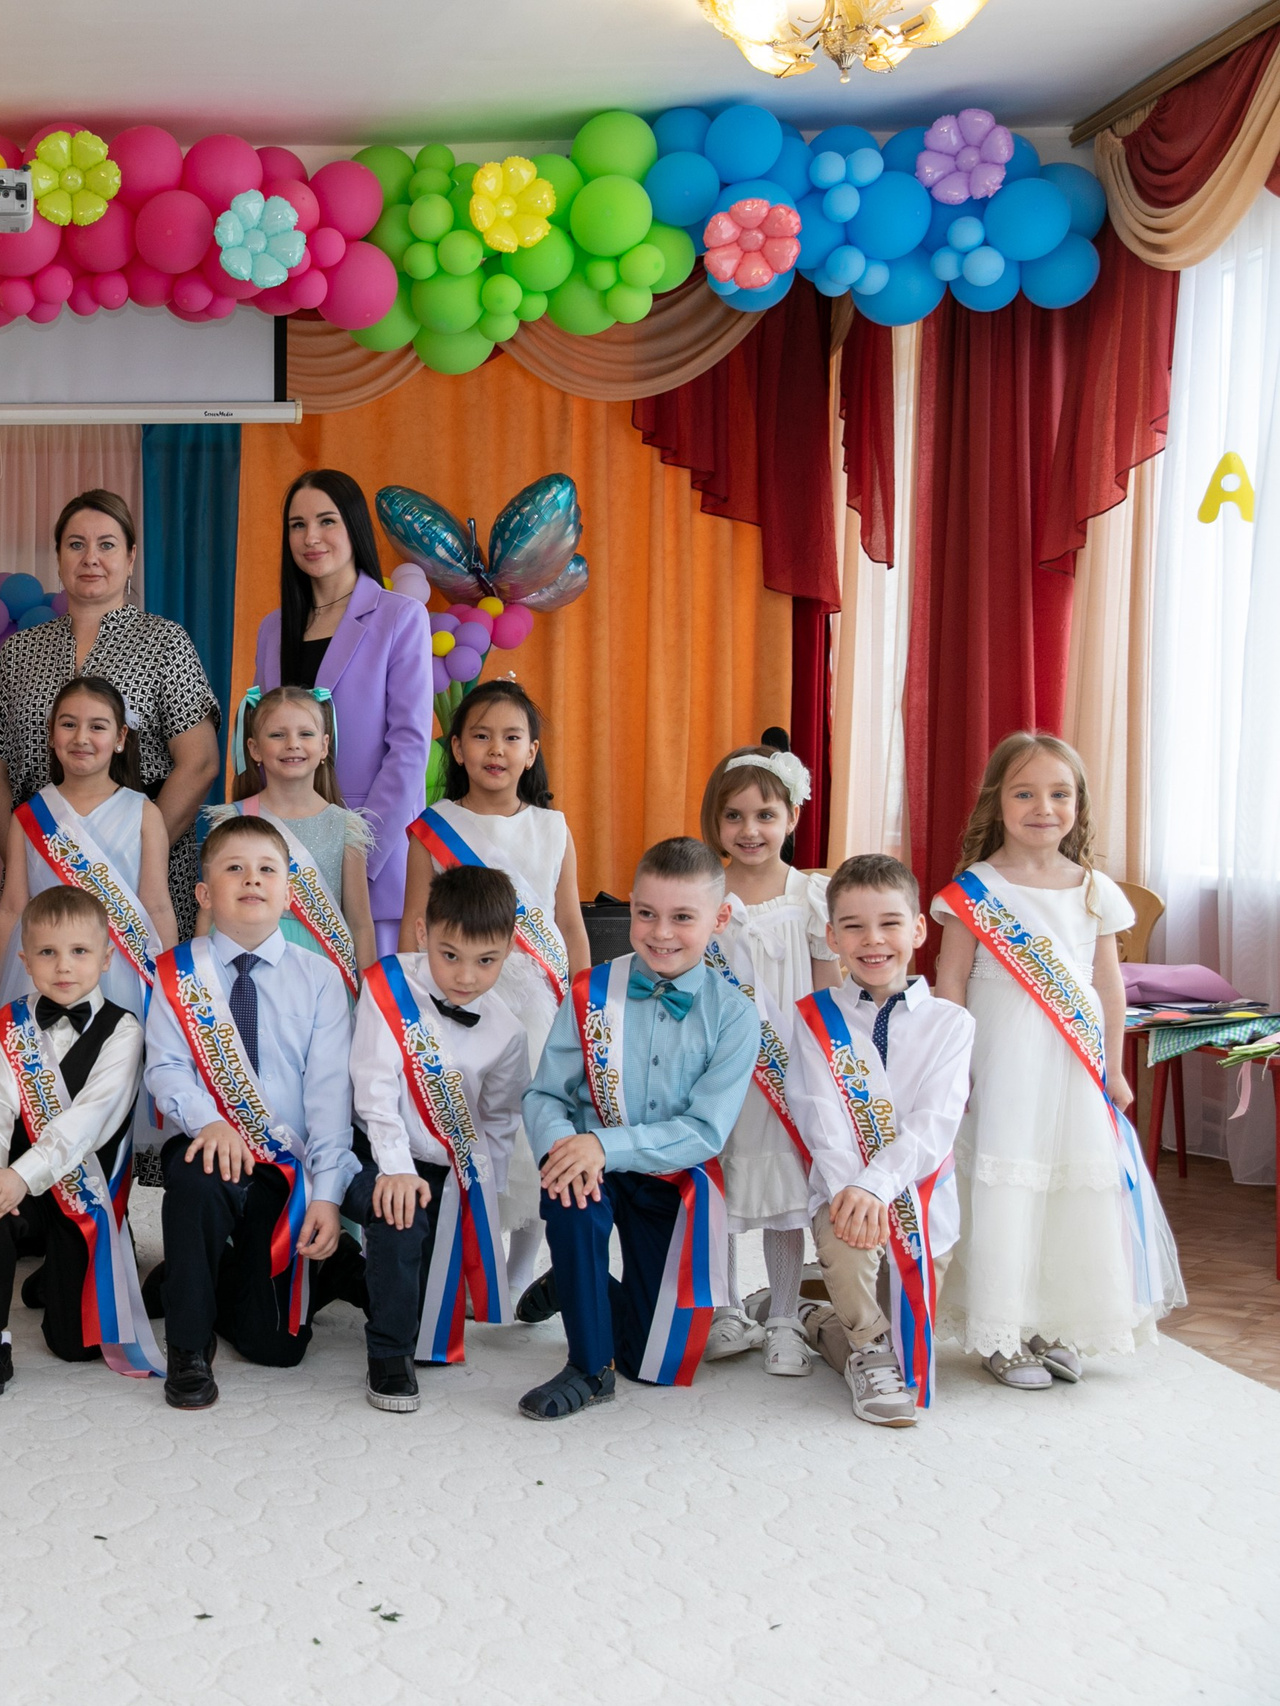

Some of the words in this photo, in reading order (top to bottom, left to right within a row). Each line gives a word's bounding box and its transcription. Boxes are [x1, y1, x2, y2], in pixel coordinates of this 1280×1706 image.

[74, 864, 128, 931] детского
[124, 933, 147, 965] сада
[92, 863, 149, 946] Выпускник
[301, 866, 354, 951] Выпускник
[1009, 936, 1076, 1017] детского
[1071, 1020, 1102, 1058] сада
[1032, 936, 1099, 1036] Выпускник
[197, 1021, 242, 1105] детского
[236, 1108, 269, 1145] сада
[218, 1022, 270, 1126] Выпускник
[423, 1070, 455, 1133] детского
[444, 1071, 478, 1149] Выпускник
